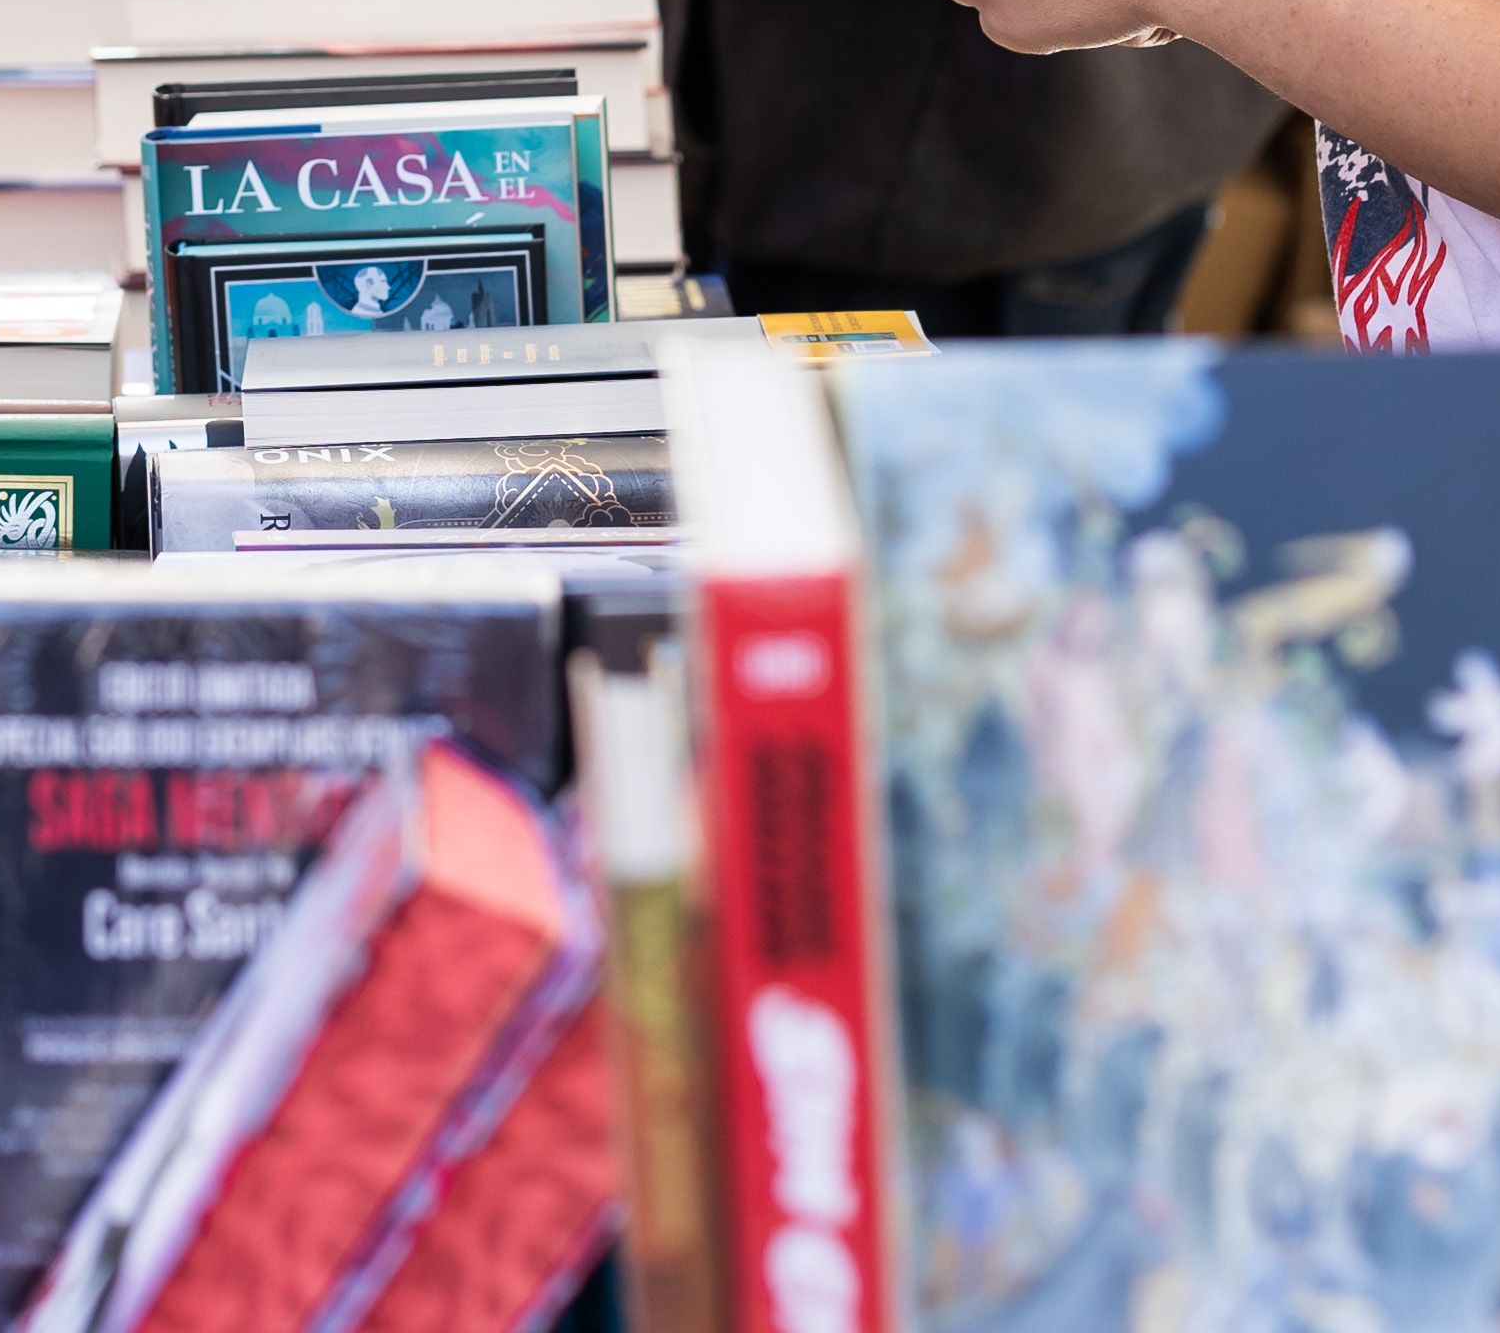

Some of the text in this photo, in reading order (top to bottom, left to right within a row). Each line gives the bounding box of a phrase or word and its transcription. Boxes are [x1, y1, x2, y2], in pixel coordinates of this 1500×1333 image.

[182, 150, 532, 216] LA CASA EN
[498, 177, 536, 201] EL
